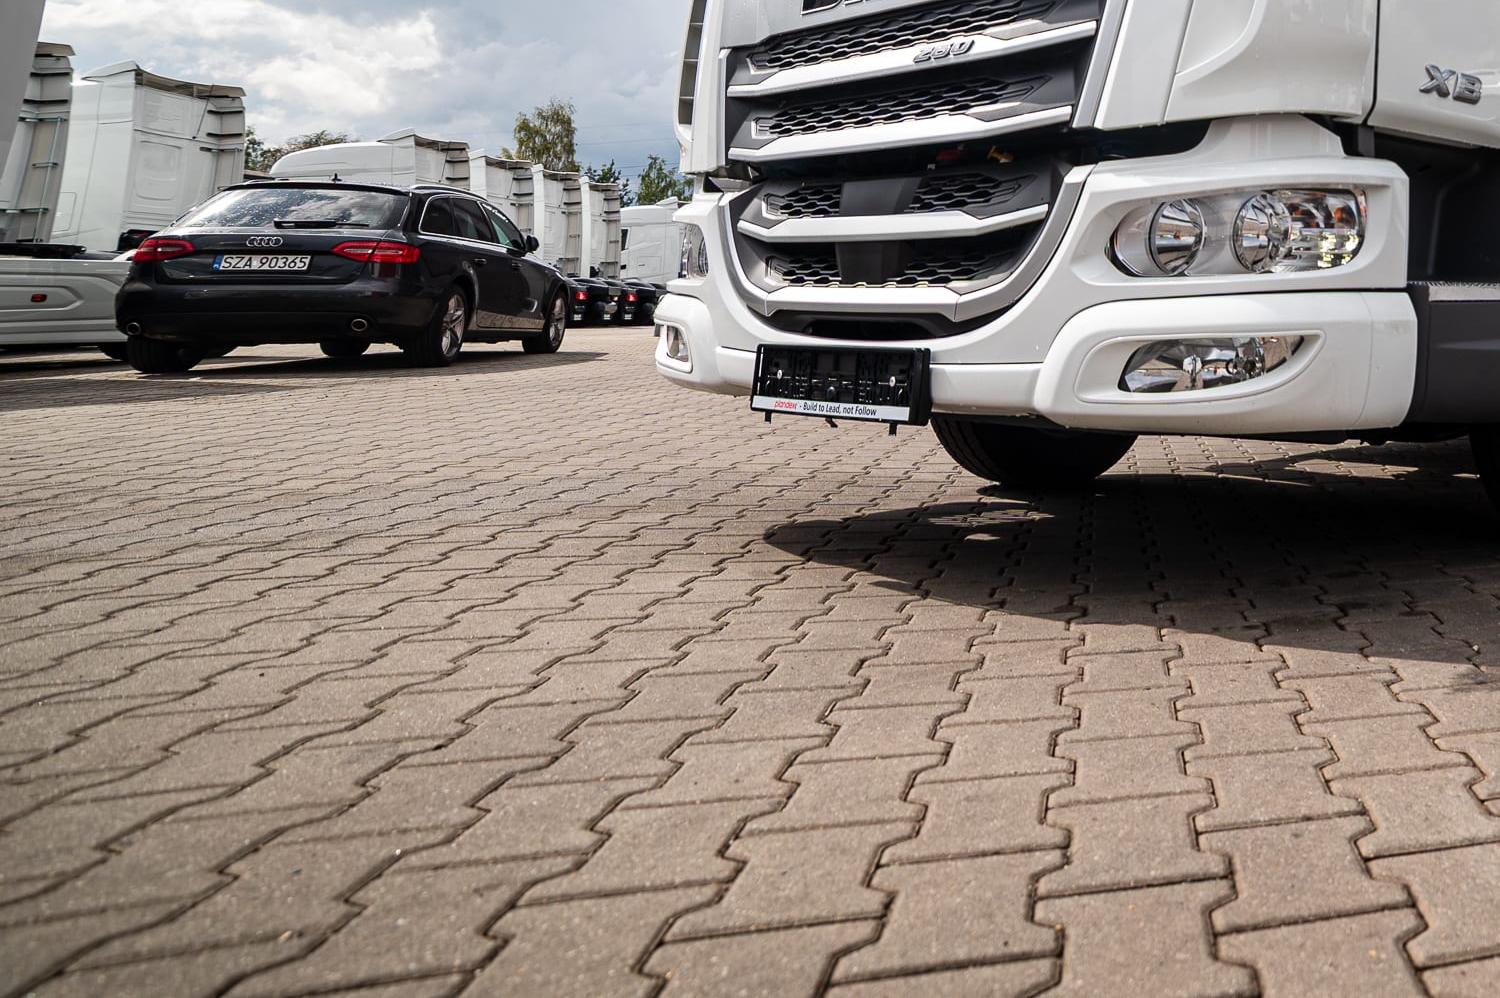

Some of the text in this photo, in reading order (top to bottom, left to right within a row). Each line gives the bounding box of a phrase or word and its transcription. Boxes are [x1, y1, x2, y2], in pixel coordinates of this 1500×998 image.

[1419, 64, 1482, 105] XB
[222, 256, 309, 269] SZA 90365
[802, 402, 817, 411] Build
[818, 403, 825, 412] to
[842, 405, 854, 415] not
[854, 406, 877, 417] Follow
